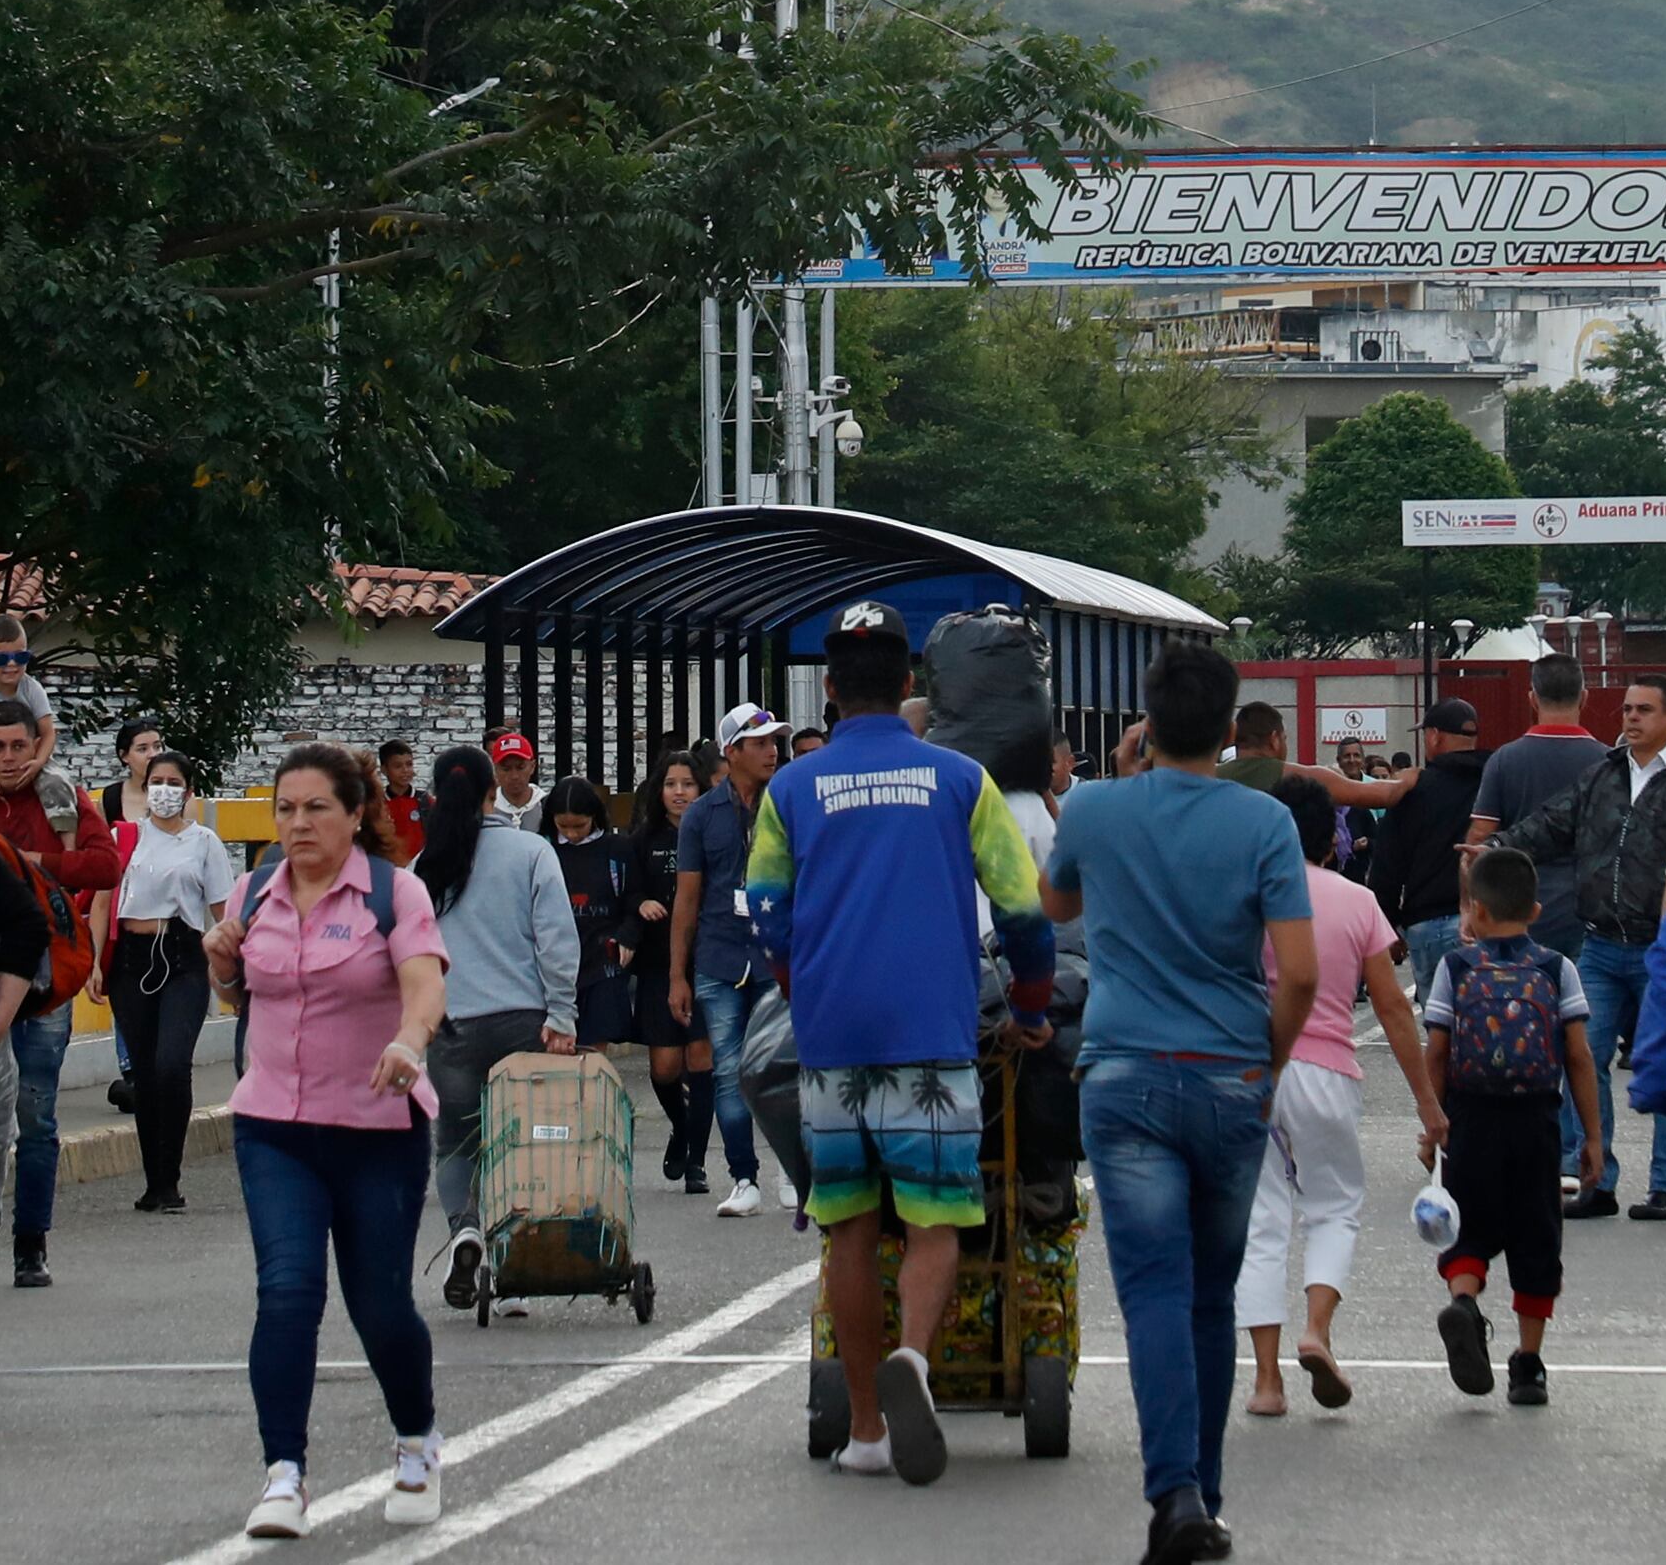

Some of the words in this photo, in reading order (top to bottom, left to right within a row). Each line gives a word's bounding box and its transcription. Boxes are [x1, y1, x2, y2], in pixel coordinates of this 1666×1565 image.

[1074, 240, 1232, 269] REPÚBLICA
[1241, 241, 1442, 266] BOLIVARIANA
[1451, 242, 1496, 266] DE
[1578, 503, 1637, 518] Aduana
[815, 774, 854, 801] PUENTE
[856, 766, 938, 791] INTERNACIONAL
[824, 788, 870, 815] SIMON
[872, 786, 930, 806] BOLIVAR
